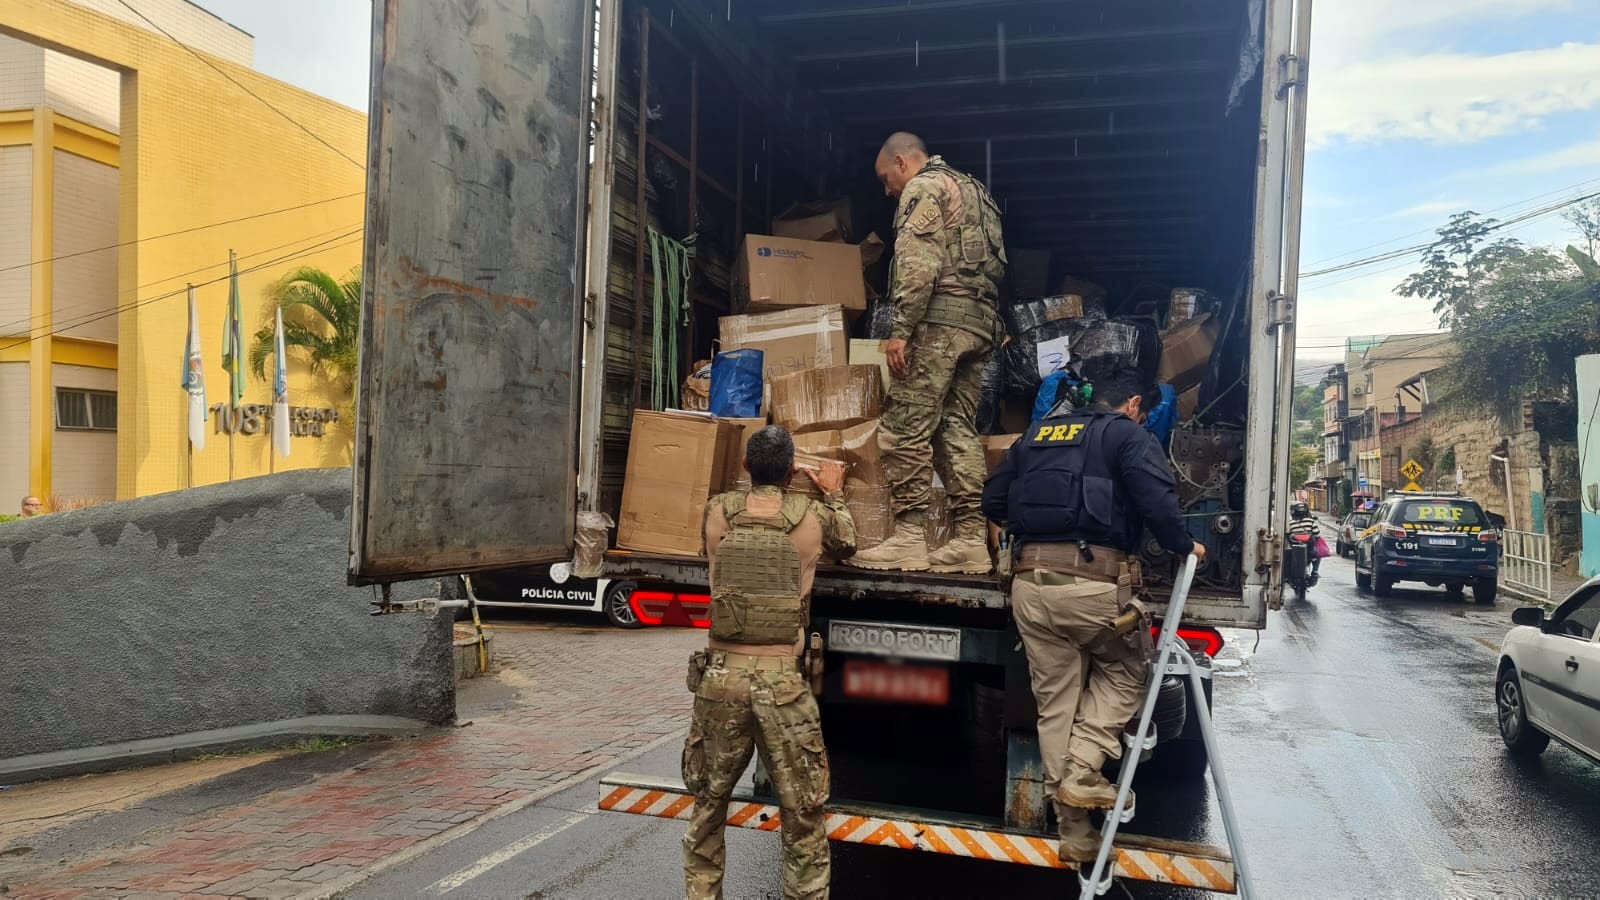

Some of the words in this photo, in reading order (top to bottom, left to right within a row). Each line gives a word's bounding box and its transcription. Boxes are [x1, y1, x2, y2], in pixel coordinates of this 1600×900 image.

[1034, 423, 1084, 441] PRF
[1417, 506, 1463, 521] PRF
[1402, 542, 1418, 550] 191
[522, 587, 564, 600] POLÍCIA
[566, 590, 596, 601] CIVIL
[837, 626, 953, 650] RODOFORT
